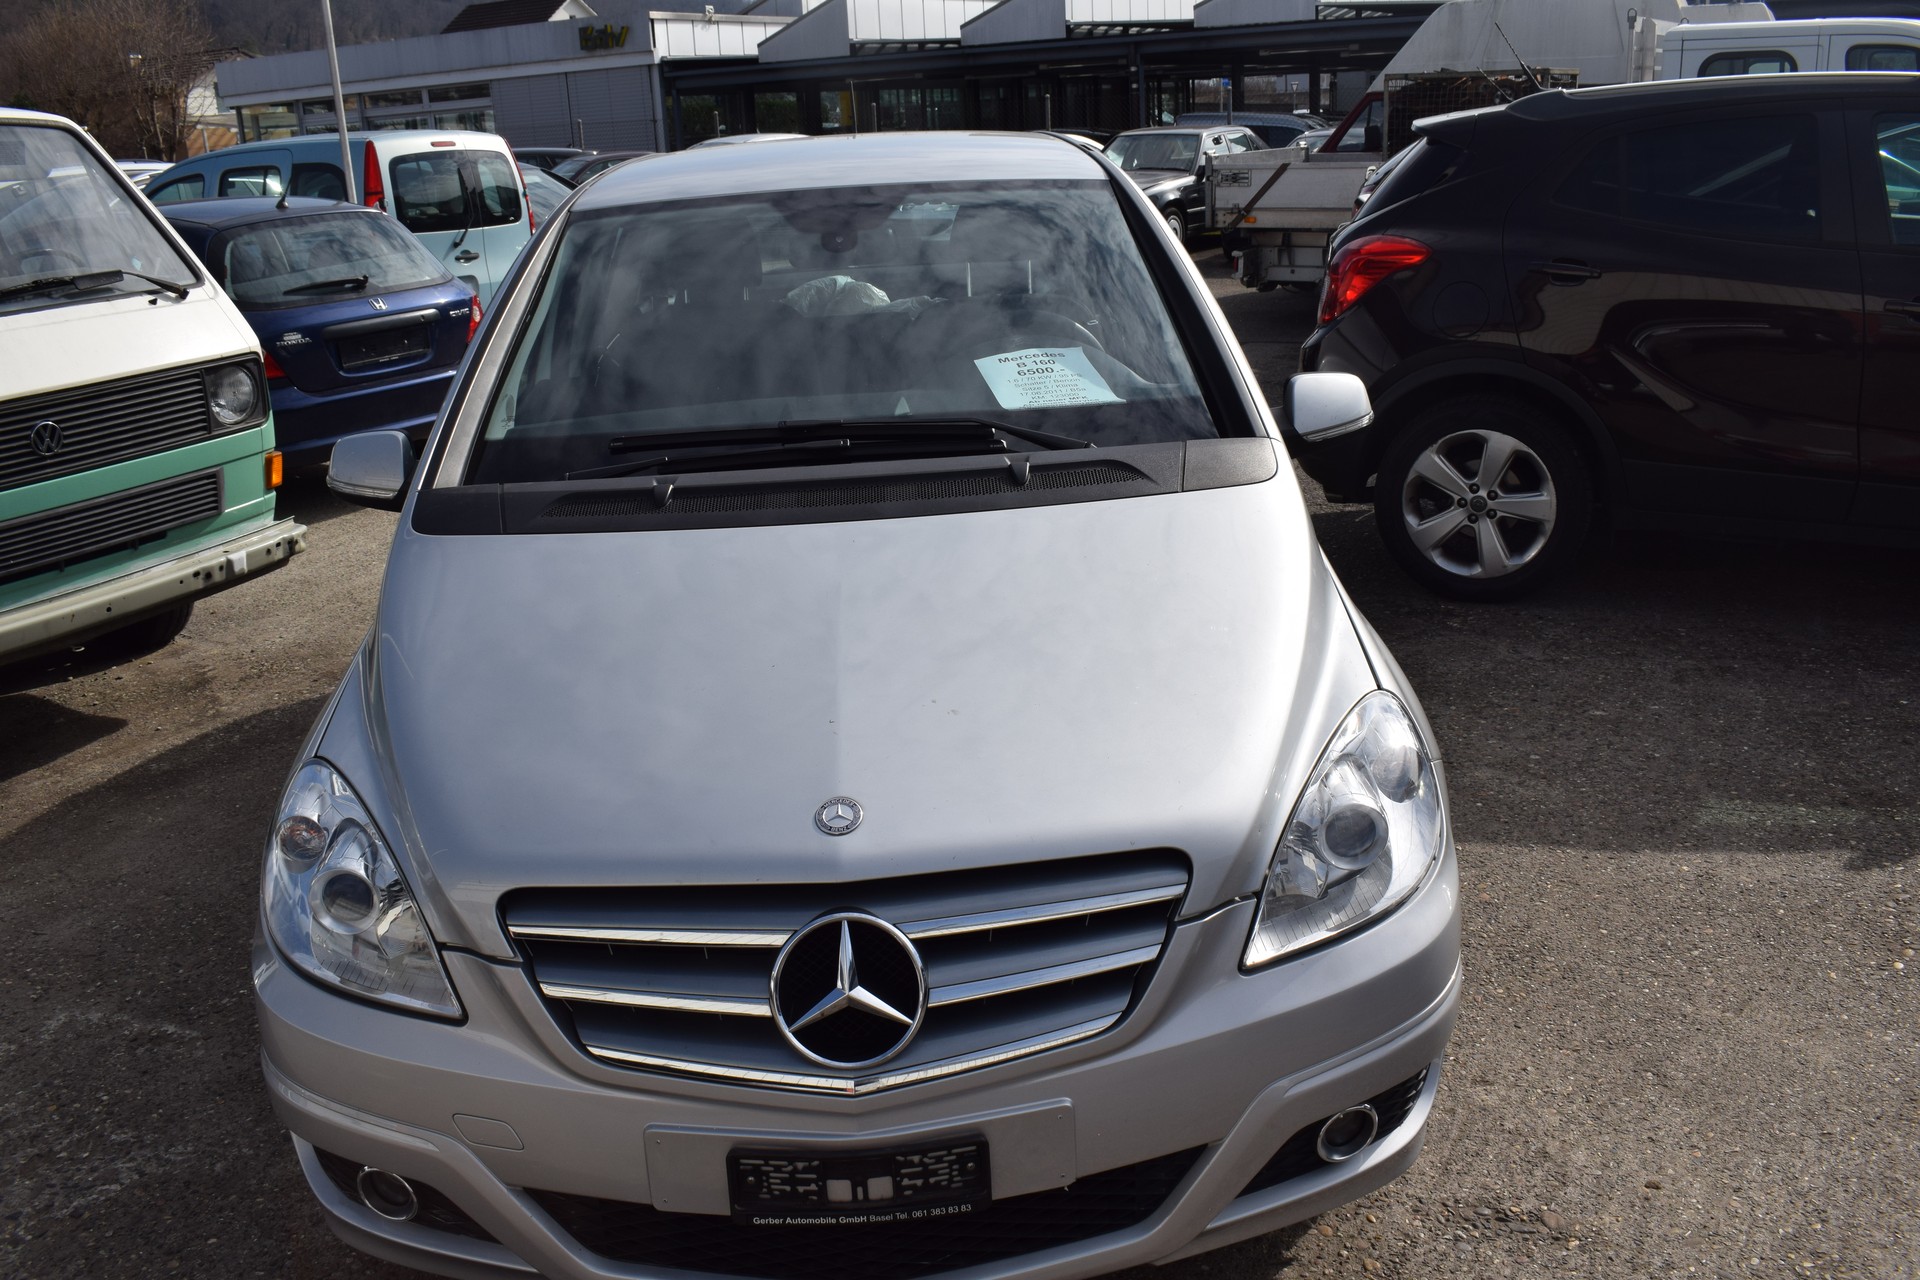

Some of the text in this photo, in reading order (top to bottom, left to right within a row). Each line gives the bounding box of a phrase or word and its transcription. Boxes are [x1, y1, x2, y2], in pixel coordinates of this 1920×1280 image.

[998, 352, 1065, 363] Mercedes
[1017, 366, 1066, 376] 6500.-
[753, 1203, 972, 1225] Gerber Automobile GmbH Basel Tel. 061 383 83 83
